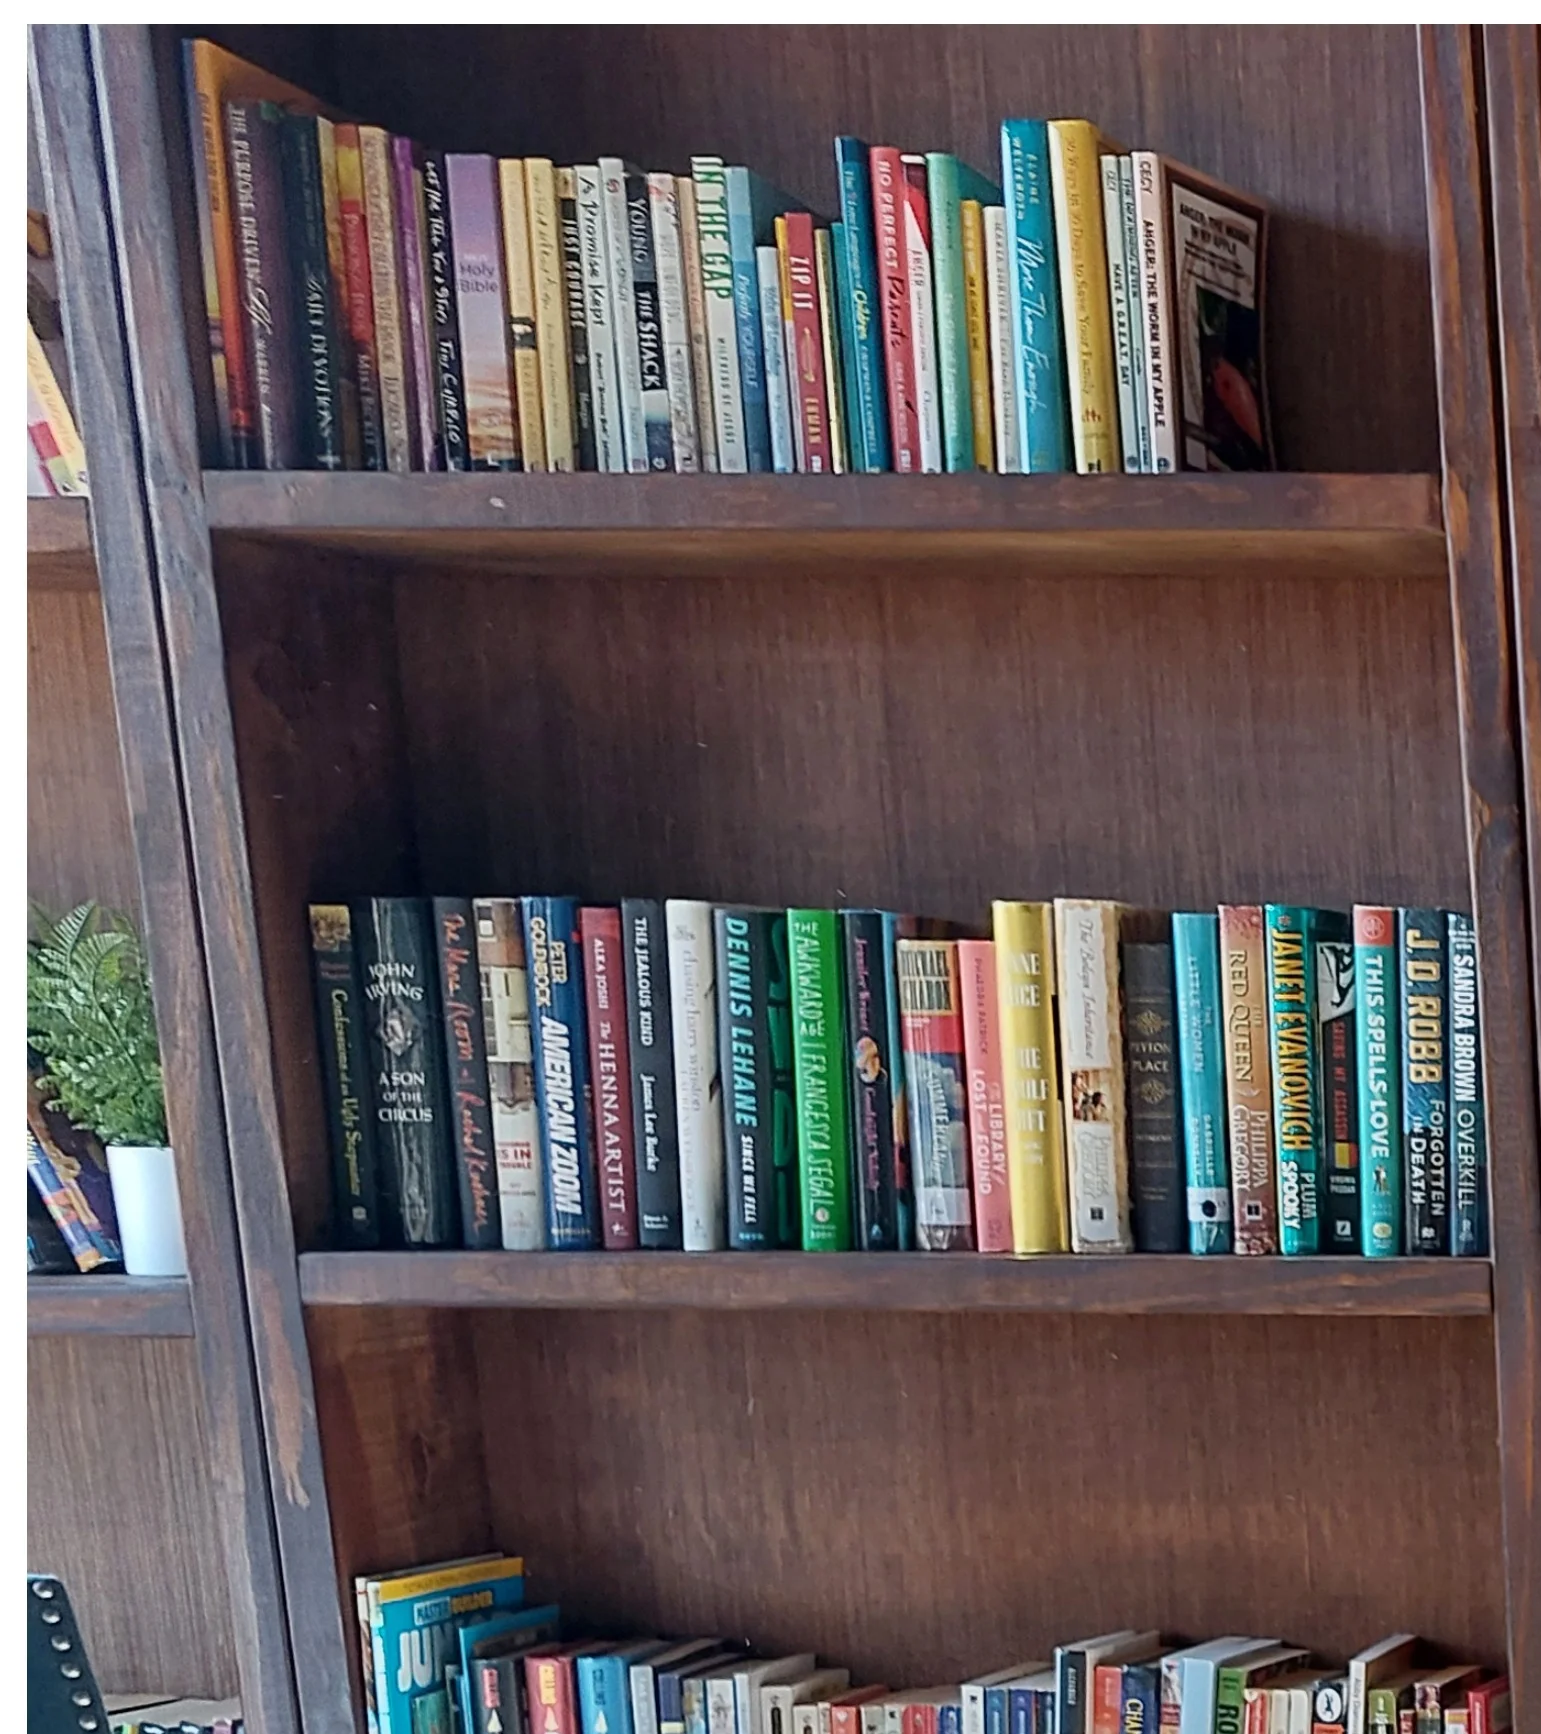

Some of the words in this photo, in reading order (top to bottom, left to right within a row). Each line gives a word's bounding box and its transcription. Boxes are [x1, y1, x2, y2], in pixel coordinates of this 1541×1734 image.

[700, 161, 726, 183] IN
[877, 160, 891, 186] NO
[631, 199, 648, 262] YOUNG
[702, 197, 727, 239] THE
[880, 193, 897, 267] PERFECT
[458, 279, 499, 293] Bible
[460, 261, 495, 279] Holy
[704, 253, 731, 299] GAP
[1147, 273, 1158, 299] THE
[639, 291, 655, 317] THE
[888, 276, 908, 350] Parents
[1148, 303, 1160, 341] WORM
[641, 322, 660, 388] SHACK
[1151, 346, 1160, 360] IN
[1152, 364, 1163, 382] MY
[1154, 387, 1165, 427] APPLE
[727, 918, 752, 1017] DENNIS
[1271, 929, 1305, 1002] JANET
[1365, 955, 1386, 1007] THIS
[1453, 955, 1473, 1029] SANDRA
[540, 1017, 572, 1140] AMERICAN
[598, 1043, 616, 1126] HENNA
[732, 1026, 757, 1127] LEHANE
[1276, 1013, 1312, 1151] EVANOVICH
[1367, 1014, 1387, 1093] SPELLS
[1455, 1034, 1475, 1102] BROWN
[1371, 1100, 1388, 1157] LOVE
[1457, 1109, 1475, 1209] OVERKILL
[550, 1142, 581, 1214] ZOOM
[605, 1131, 625, 1212] ARTIST
